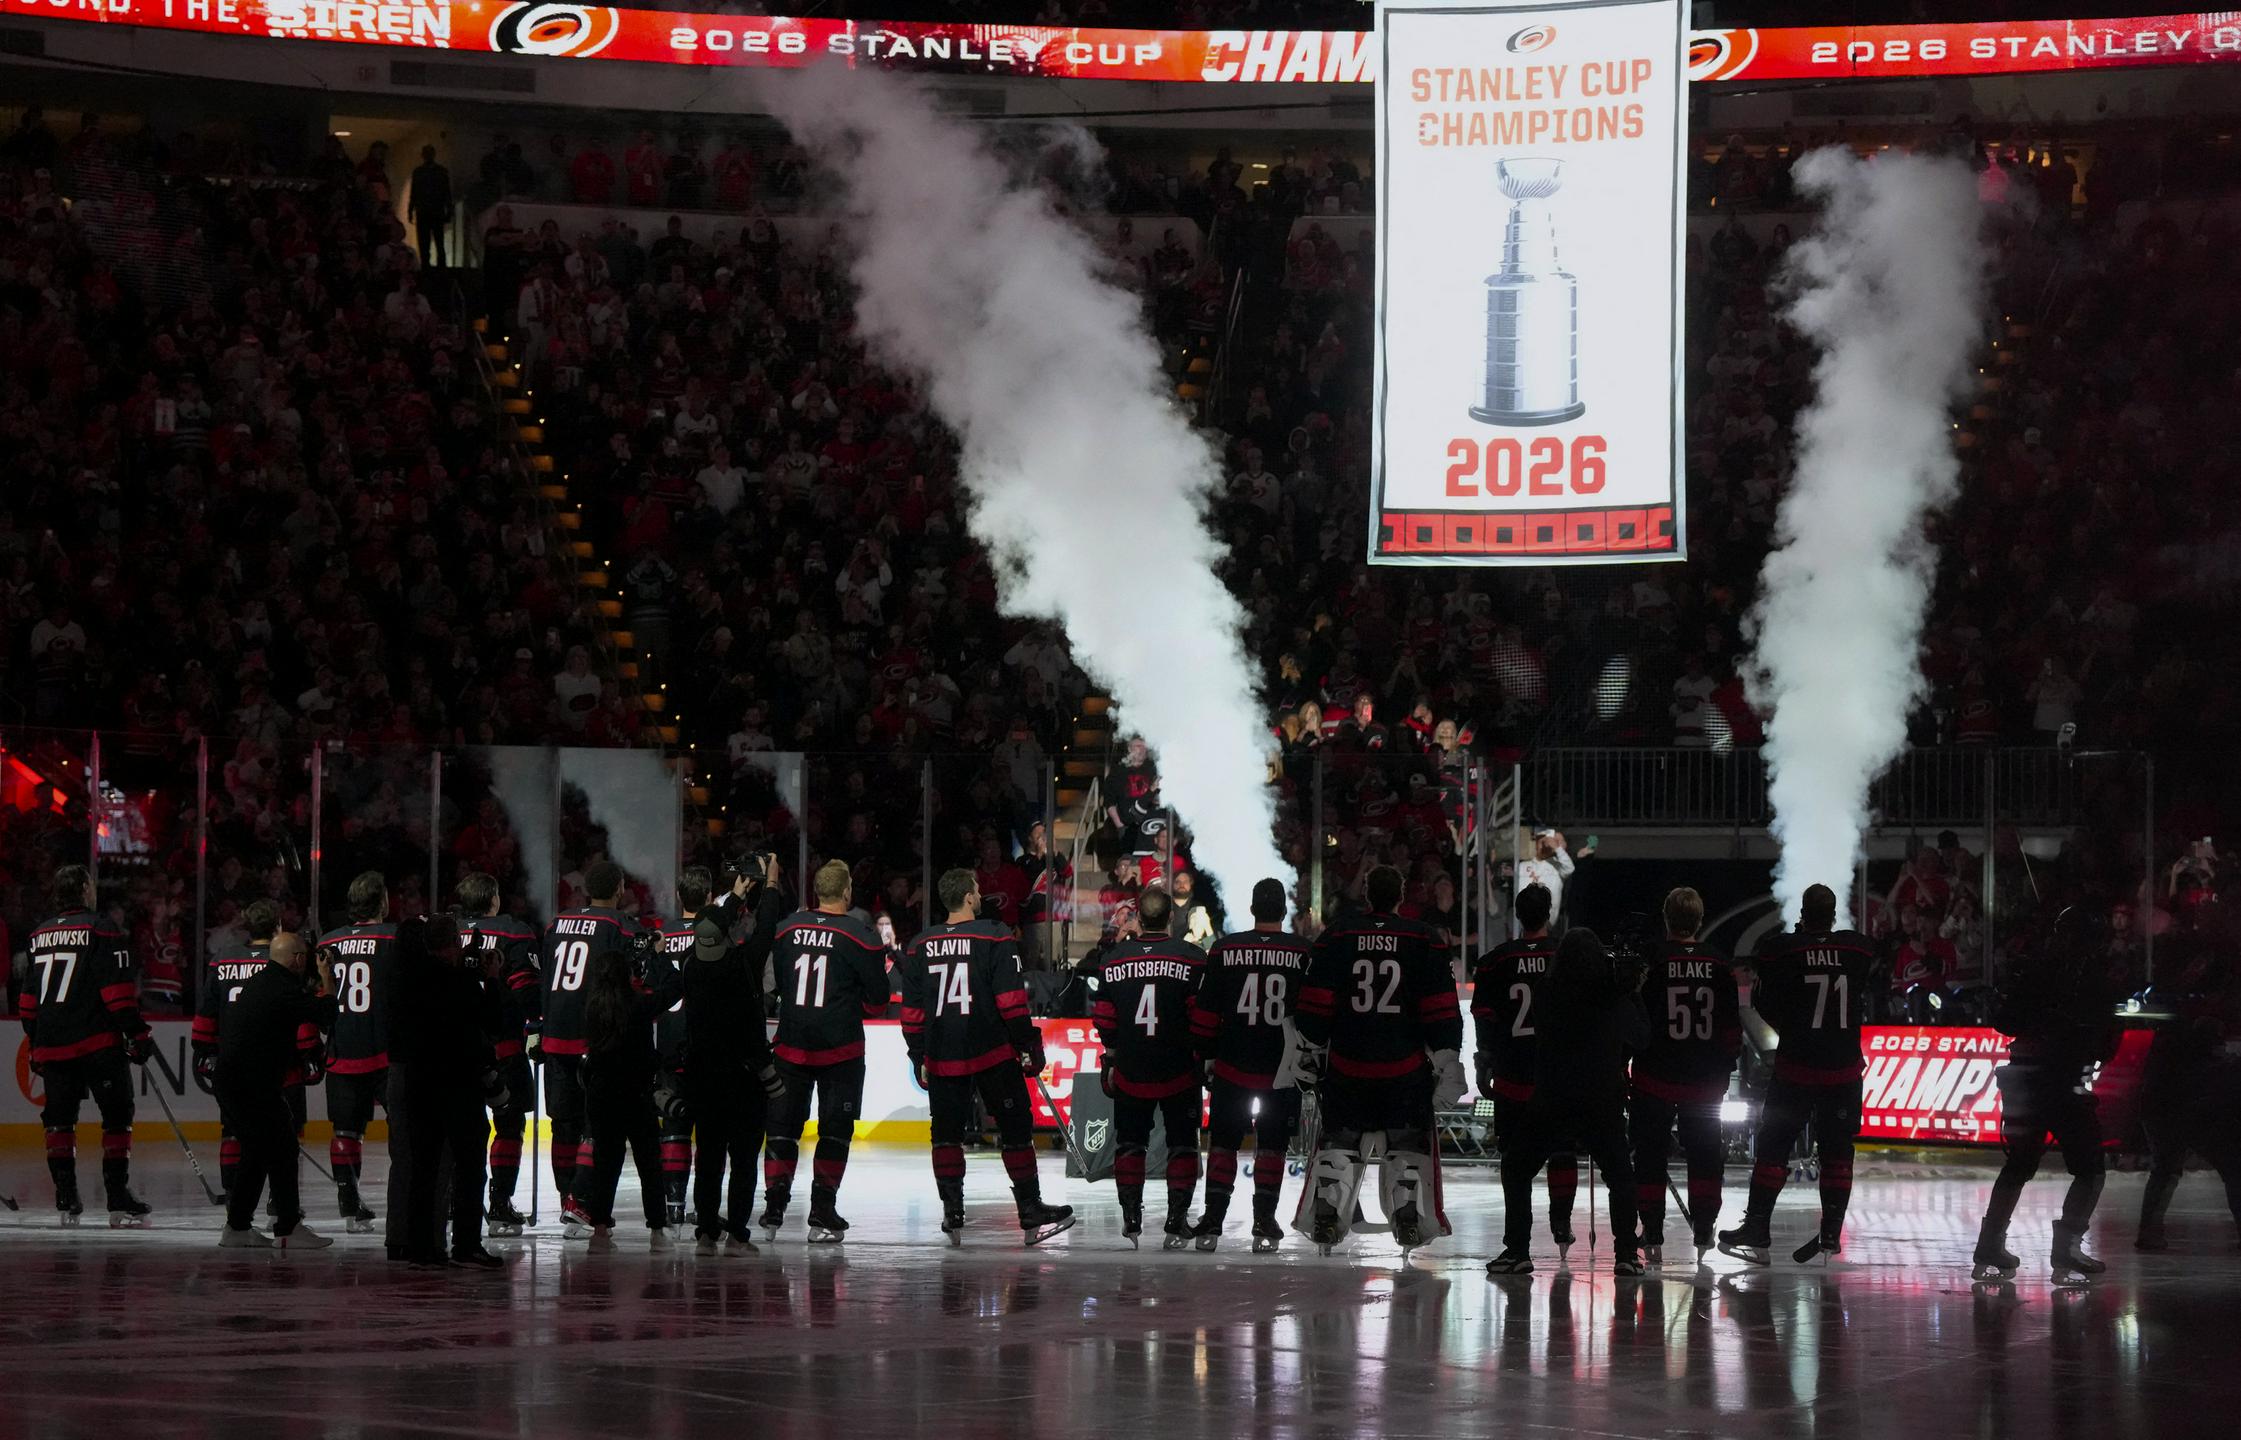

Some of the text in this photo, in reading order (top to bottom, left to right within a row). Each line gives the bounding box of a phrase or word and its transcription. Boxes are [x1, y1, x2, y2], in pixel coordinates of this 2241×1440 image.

[265, 0, 450, 40] SIREN
[670, 27, 1164, 66] 2026 STANLEY CUP
[1811, 39, 1948, 63] 2026
[1969, 29, 2193, 58] STANLEY
[1410, 58, 1652, 103] STANLEY CUP
[1418, 103, 1644, 147] CHAMPIONS
[1445, 434, 1607, 497] 2026
[30, 930, 89, 953] JNKOWSKI
[556, 918, 597, 936] MILLER
[793, 929, 834, 949] STAAL
[1357, 935, 1399, 953] BUSSI
[330, 939, 377, 955] ARRIER
[551, 940, 589, 992] 19
[926, 938, 971, 958] SLAVIN
[1222, 948, 1301, 970] MARTINOOK
[1516, 958, 1546, 975] AHO
[1805, 950, 1843, 968] HALL
[35, 952, 77, 1005] 77
[334, 961, 371, 1013] 28
[795, 953, 827, 1008] 11
[928, 962, 973, 1017] 74
[1105, 962, 1191, 984] GOSTISBEHERE
[1351, 958, 1402, 1014] 32
[1667, 961, 1713, 980] BLAKE
[1134, 983, 1159, 1037] 4
[1237, 972, 1287, 1027] 48
[1666, 985, 1716, 1041] 53
[1804, 973, 1849, 1030] 71
[1870, 1035, 2012, 1053] 2026 STANL
